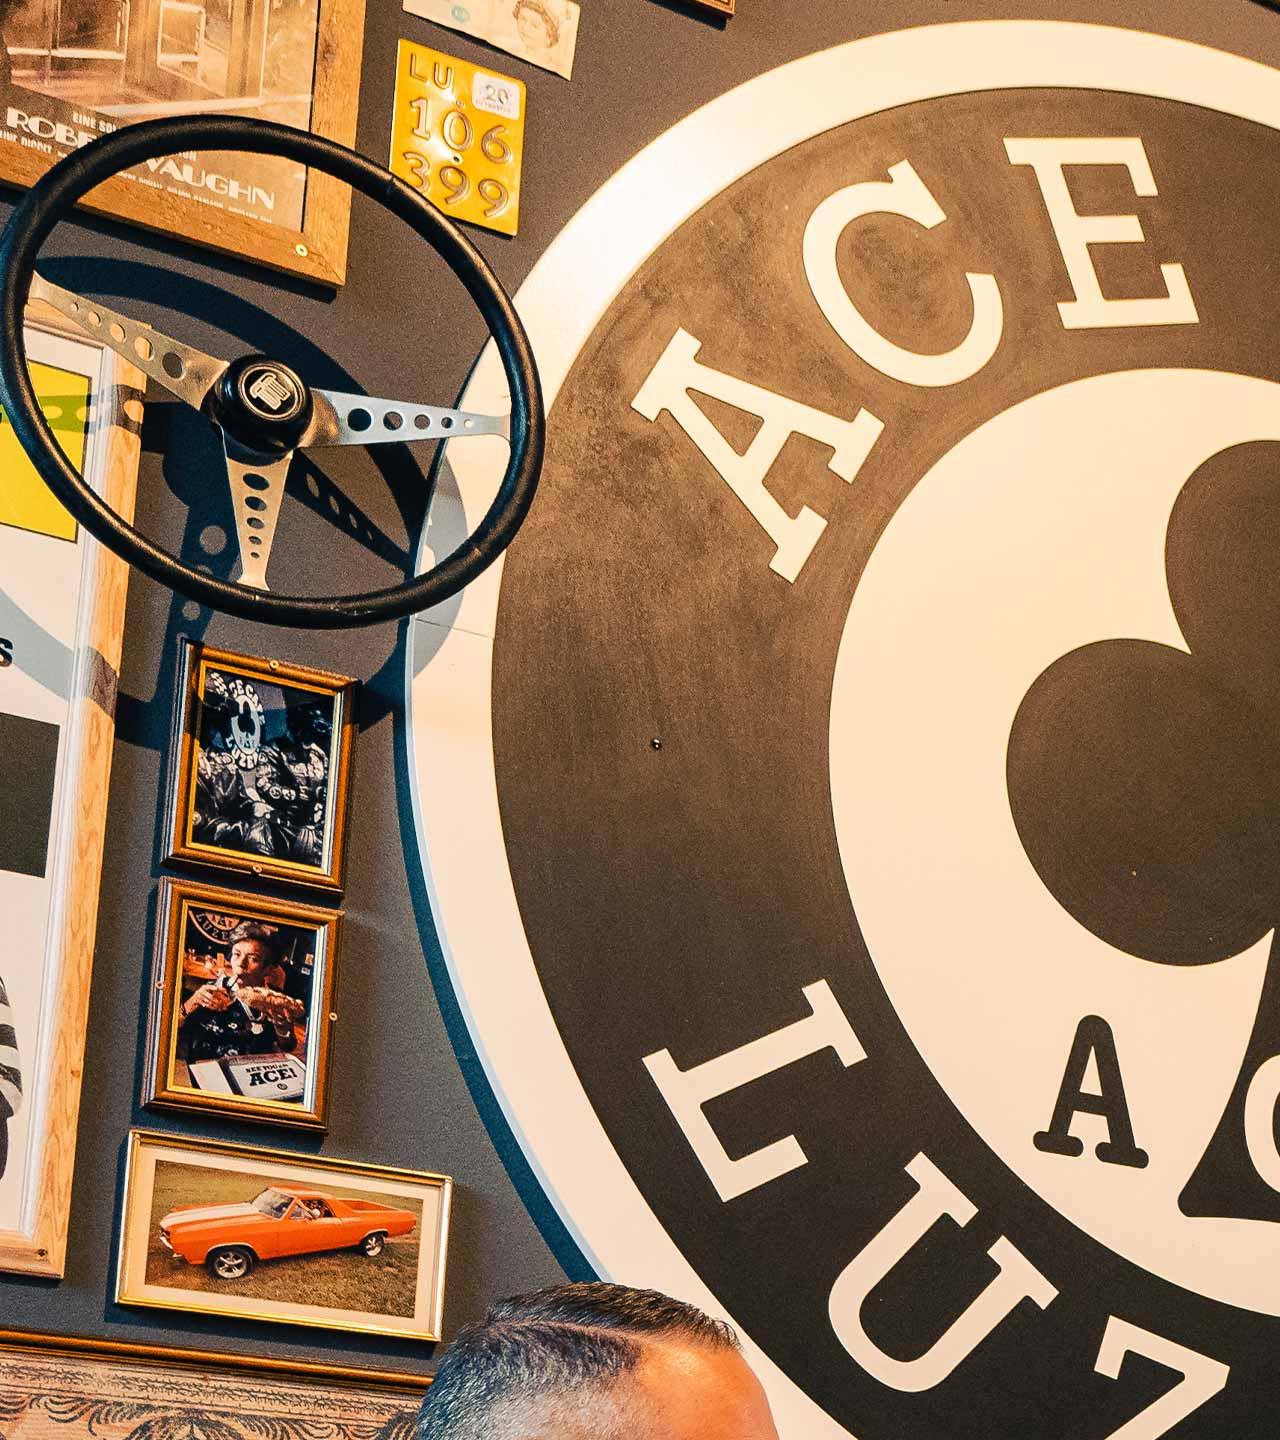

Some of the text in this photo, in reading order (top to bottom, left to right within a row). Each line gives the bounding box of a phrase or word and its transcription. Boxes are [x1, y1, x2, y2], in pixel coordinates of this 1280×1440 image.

[410, 53, 453, 89] LU
[72, 111, 97, 130] EINE
[410, 96, 511, 164] 106
[146, 157, 275, 210] VAUGHN
[402, 152, 509, 218] 399
[631, 137, 1200, 584] ACE
[249, 1067, 298, 1087] ACE!
